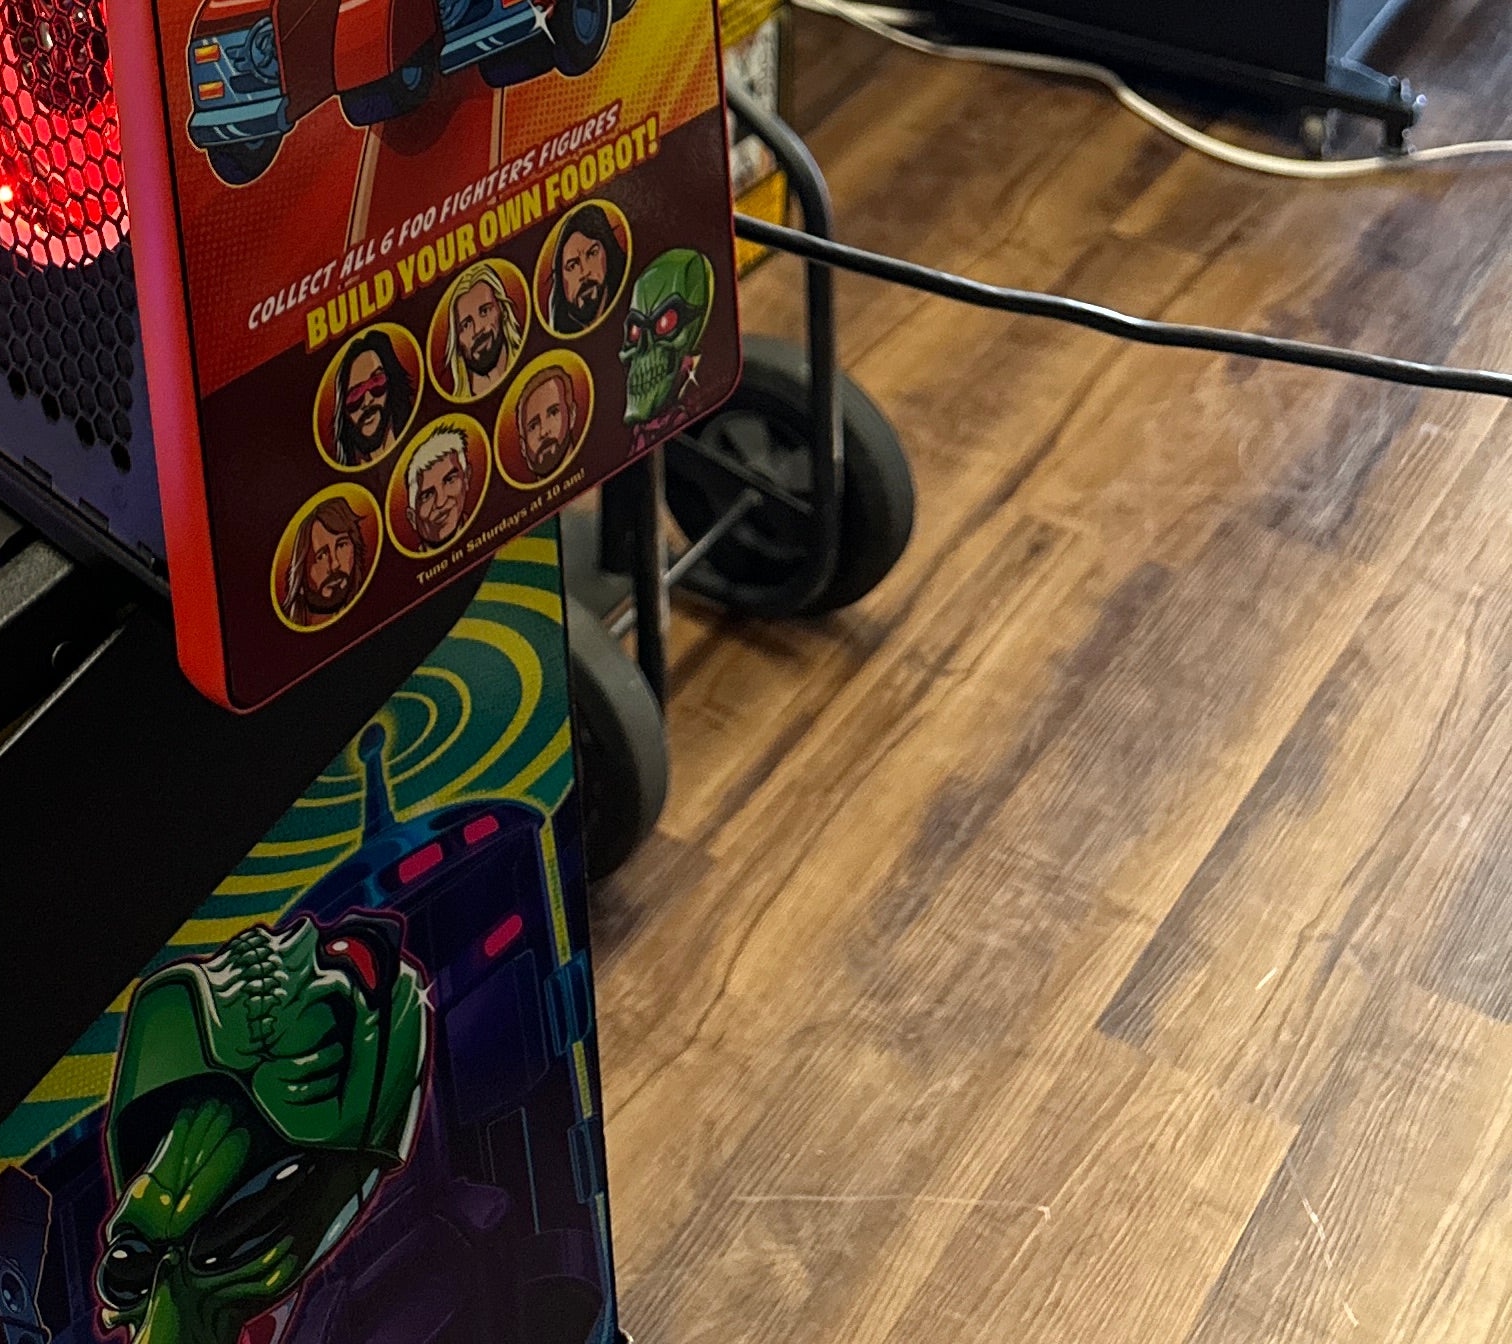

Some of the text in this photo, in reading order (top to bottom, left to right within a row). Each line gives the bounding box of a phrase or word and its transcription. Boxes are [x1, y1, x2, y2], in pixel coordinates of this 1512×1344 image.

[247, 102, 621, 332] COLLECT ALL 6 FOO FIGHTERS FIGURES
[306, 115, 661, 350] BUILD YOUR OWN FOOBOT!
[416, 467, 586, 585] Tune in Saturdays at 10 am!
